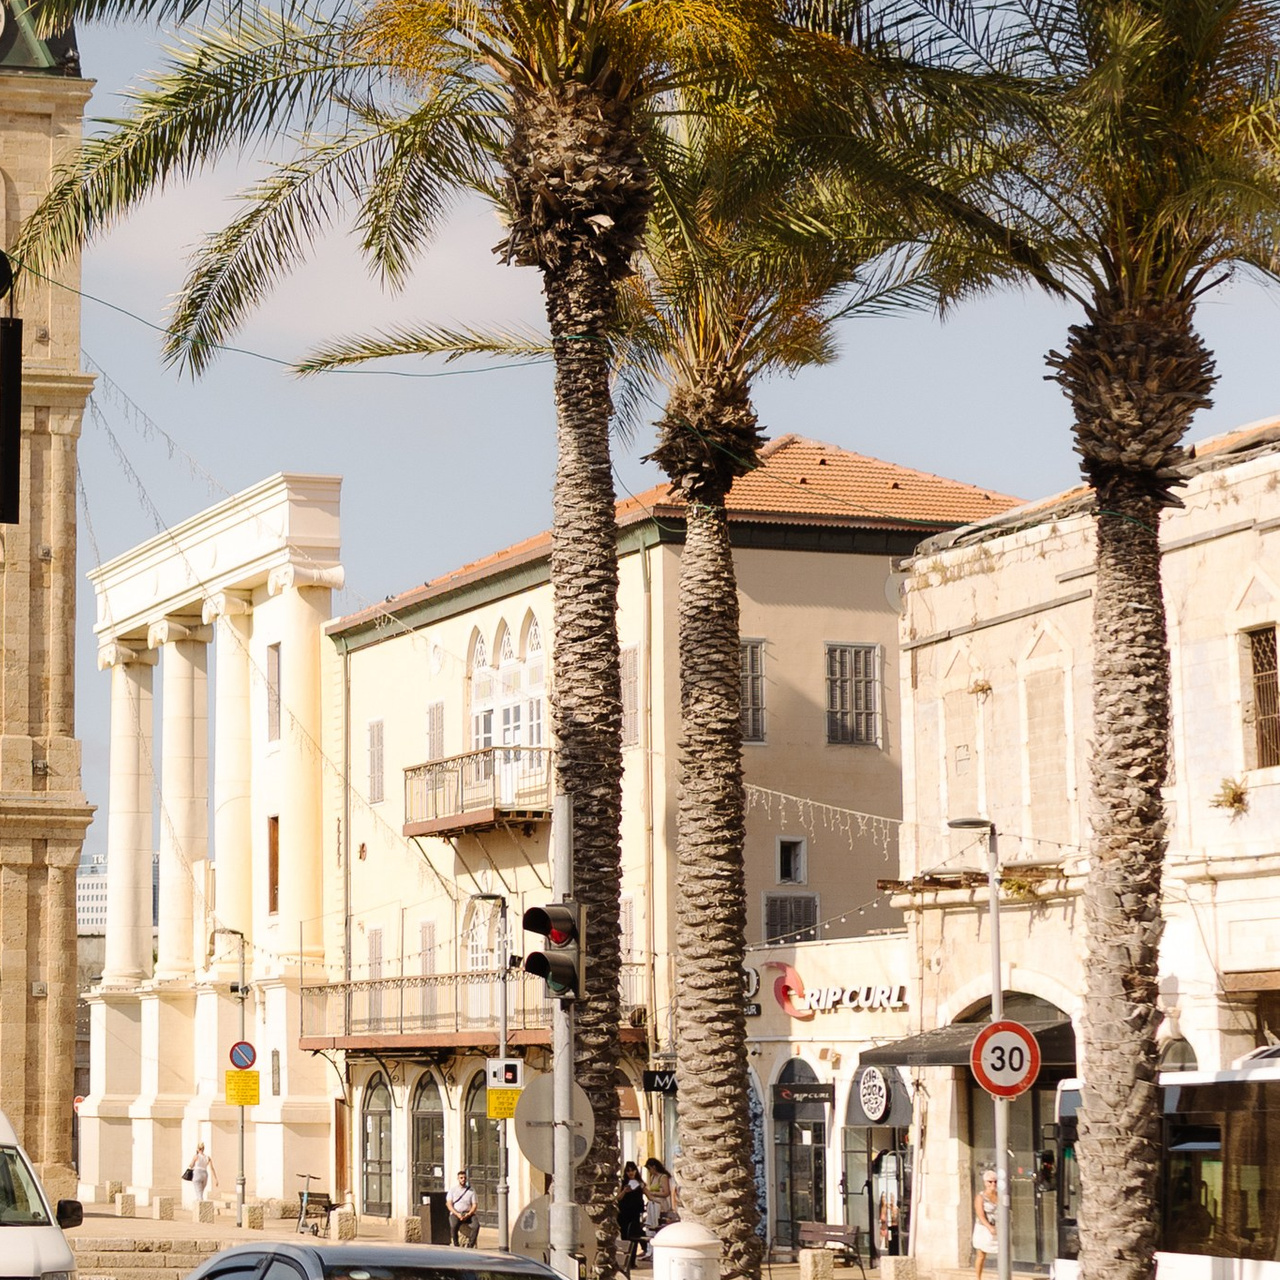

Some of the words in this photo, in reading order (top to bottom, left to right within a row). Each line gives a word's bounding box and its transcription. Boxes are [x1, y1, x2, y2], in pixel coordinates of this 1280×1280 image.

[802, 987, 843, 1010] RIP
[838, 984, 904, 1009] CURL
[990, 1046, 1024, 1072] 30
